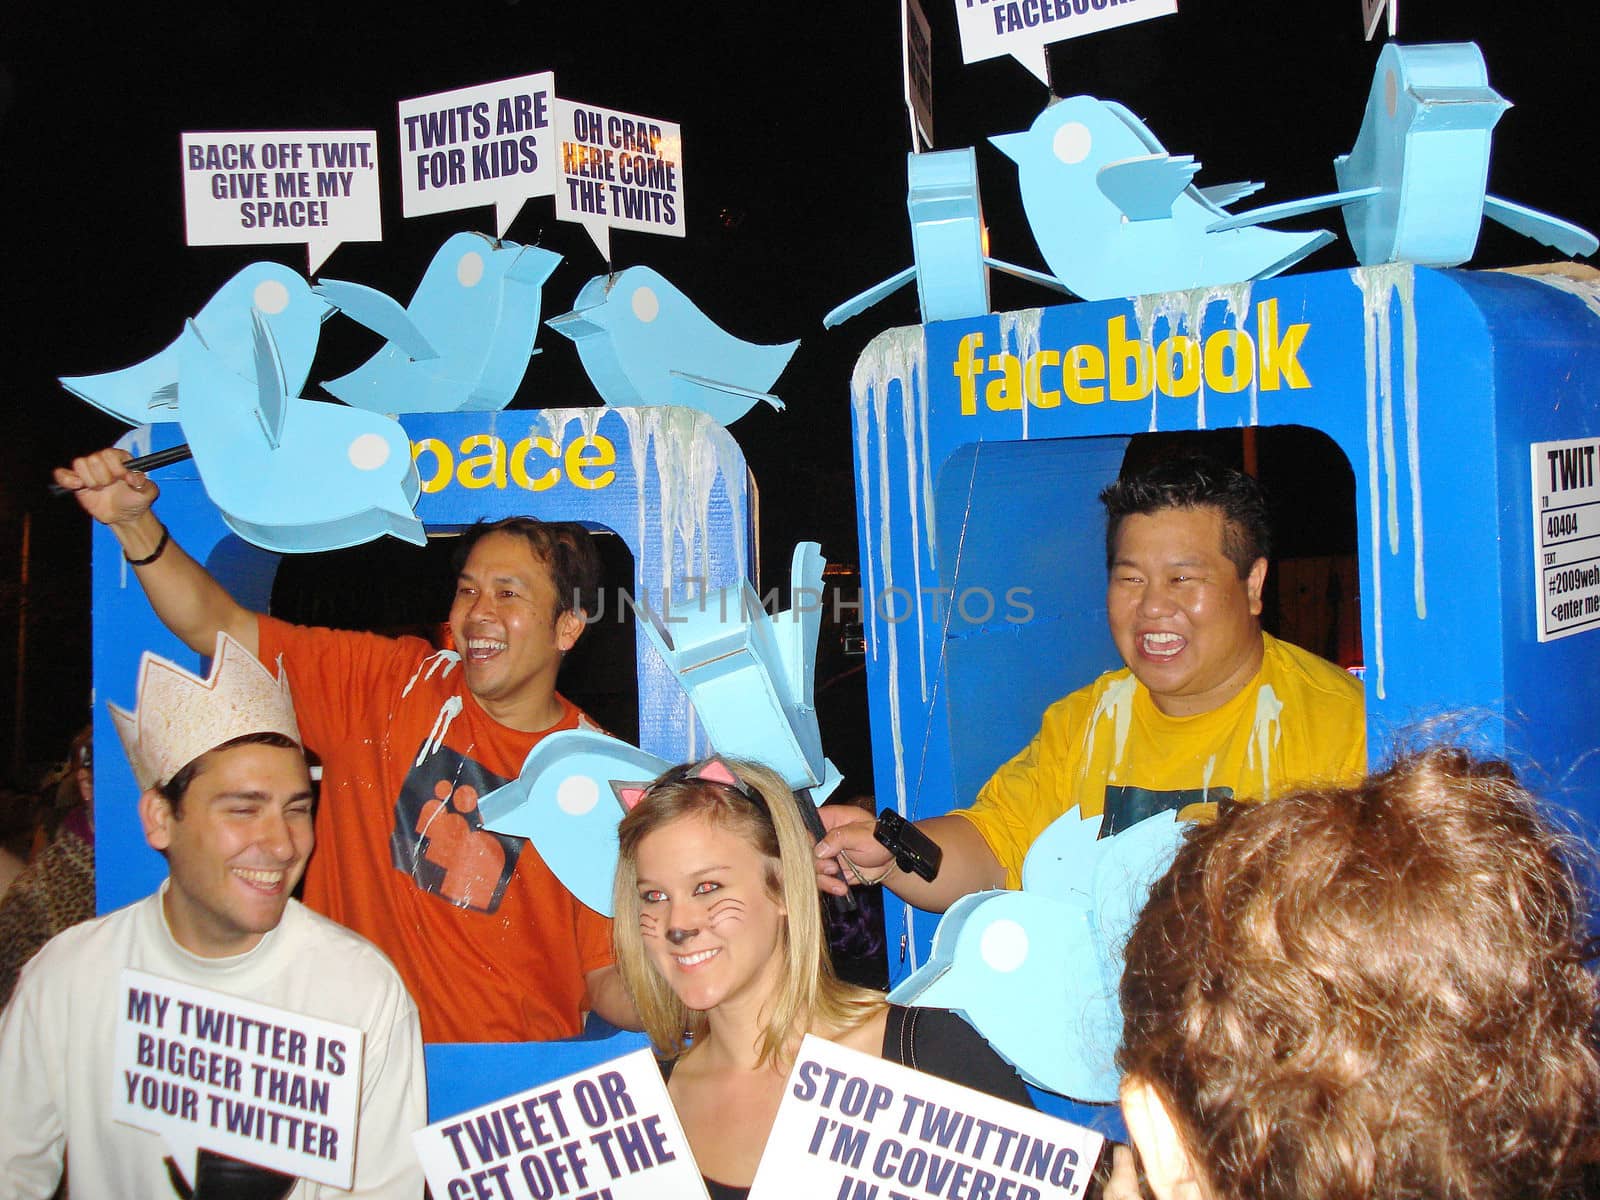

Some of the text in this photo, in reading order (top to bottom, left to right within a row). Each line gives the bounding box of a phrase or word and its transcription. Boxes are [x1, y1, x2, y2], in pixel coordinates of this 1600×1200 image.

[994, 0, 1137, 35] FACEBO
[404, 90, 548, 152] TWITS ARE
[574, 109, 663, 160] OH CRAP,
[188, 143, 374, 170] BACK OFF TWIT,
[417, 135, 538, 191] FOR KIDS
[563, 141, 677, 192] HERE COME
[212, 171, 353, 199] GIVE ME MY
[566, 177, 676, 225] THE TWITS
[240, 201, 328, 228] SPACE!
[953, 298, 1312, 416] facebook
[1548, 446, 1594, 492] TWIT
[1547, 513, 1577, 539] 40404
[1544, 552, 1556, 565] TEXT
[1551, 594, 1600, 621] <enter me
[127, 987, 346, 1077] MY TWITTER IS
[137, 1032, 330, 1116] BIGGER THAN
[124, 1070, 339, 1162] YOUR TWITTER
[441, 1070, 637, 1171] TWEET OR
[793, 1060, 1080, 1196] STOP TWITTING,
[520, 1140, 588, 1200] OFF
[590, 1114, 676, 1180] THE
[807, 1115, 871, 1170] I'M
